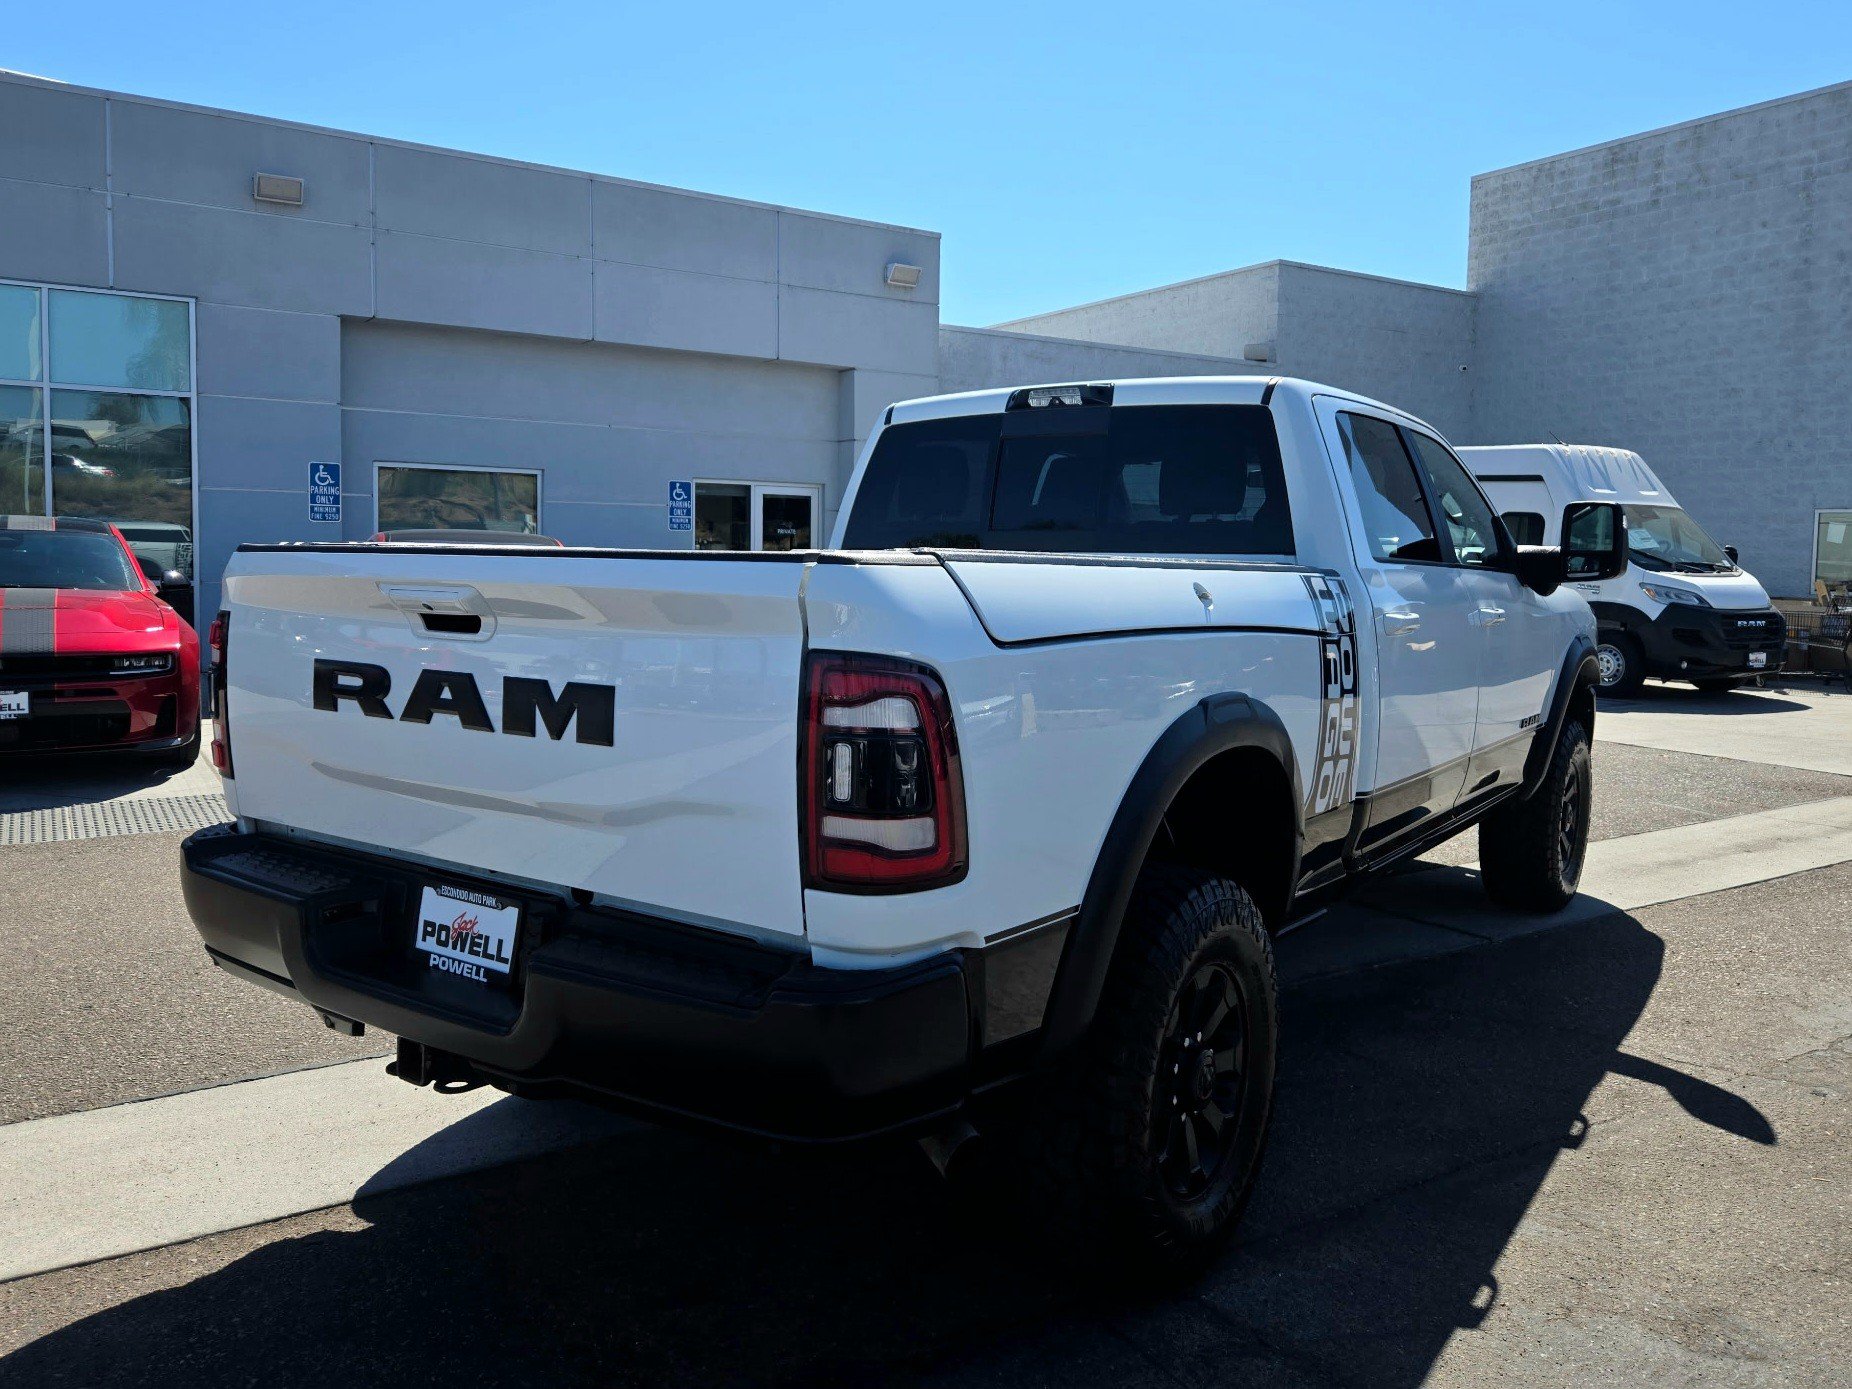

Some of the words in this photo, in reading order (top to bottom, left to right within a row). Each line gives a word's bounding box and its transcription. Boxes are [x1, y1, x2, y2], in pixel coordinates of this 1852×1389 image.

[310, 485, 340, 495] PARKING
[315, 495, 334, 504] ONLY
[669, 500, 691, 509] PARKING
[673, 508, 688, 516] ONLY
[313, 658, 616, 747] RAM
[1309, 576, 1341, 815] WAGO
[1325, 578, 1354, 807] POWE
[0, 702, 26, 711] ELL
[441, 885, 469, 901] ESCONDIDO
[469, 892, 482, 904] AUTO
[482, 895, 497, 907] PARK
[451, 911, 480, 941] Jack
[421, 919, 510, 965] POWELL
[429, 953, 488, 983] POWELL
